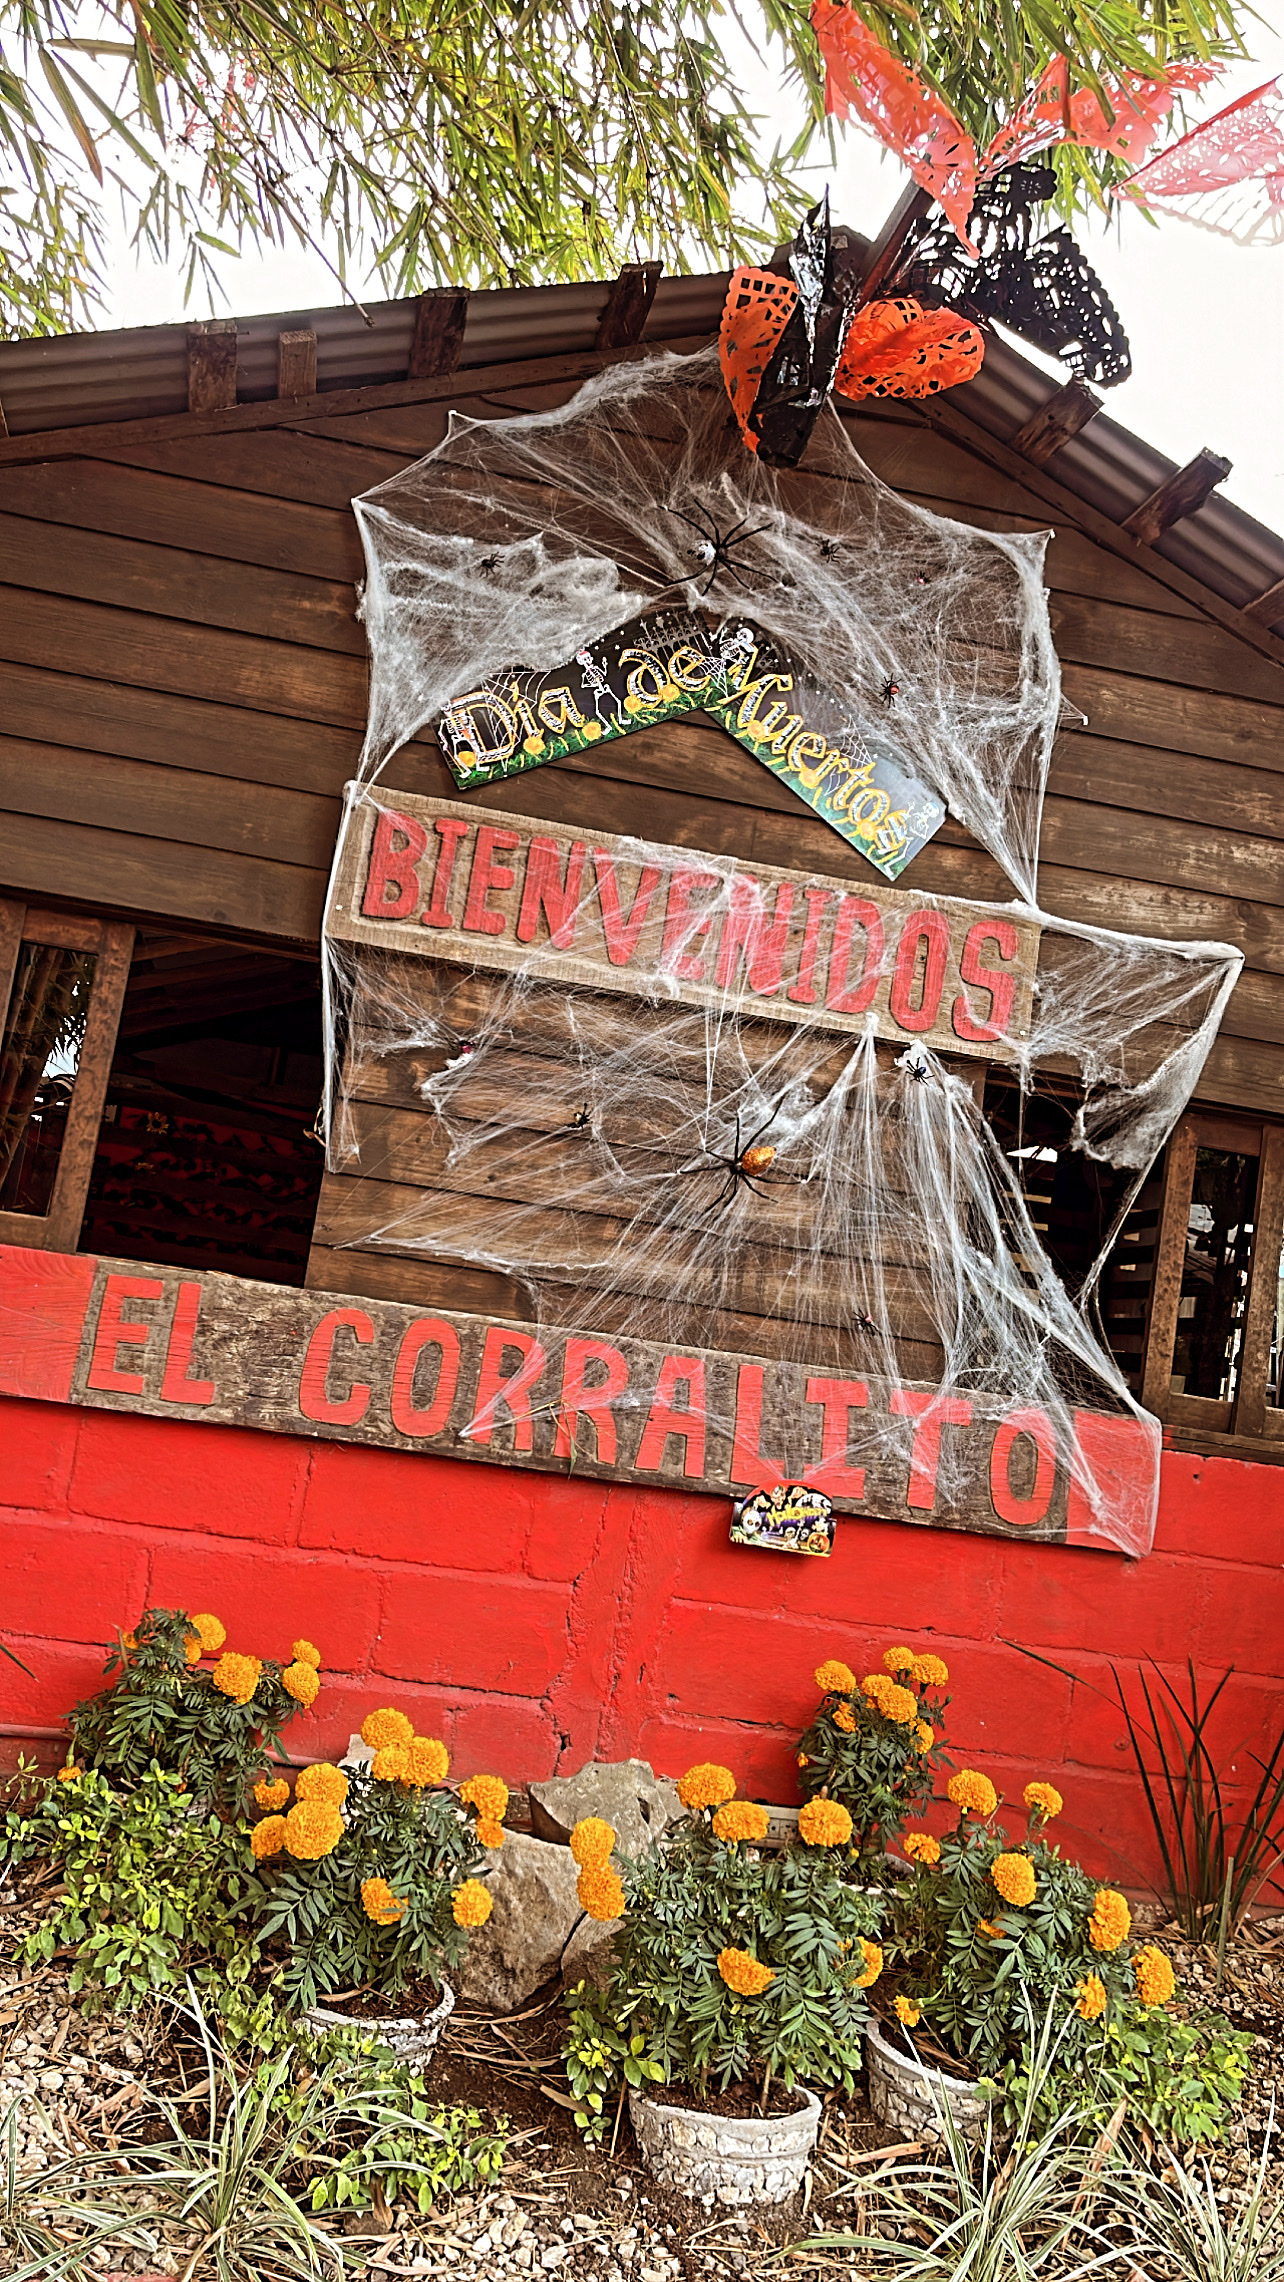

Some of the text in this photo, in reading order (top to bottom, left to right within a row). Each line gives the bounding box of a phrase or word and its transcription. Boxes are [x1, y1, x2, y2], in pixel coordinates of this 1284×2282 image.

[617, 645, 711, 709] de
[717, 642, 908, 853] Muertos
[361, 809, 1020, 1042] BIENVENIDOS
[87, 1273, 1058, 1526] EL CORRALITO
